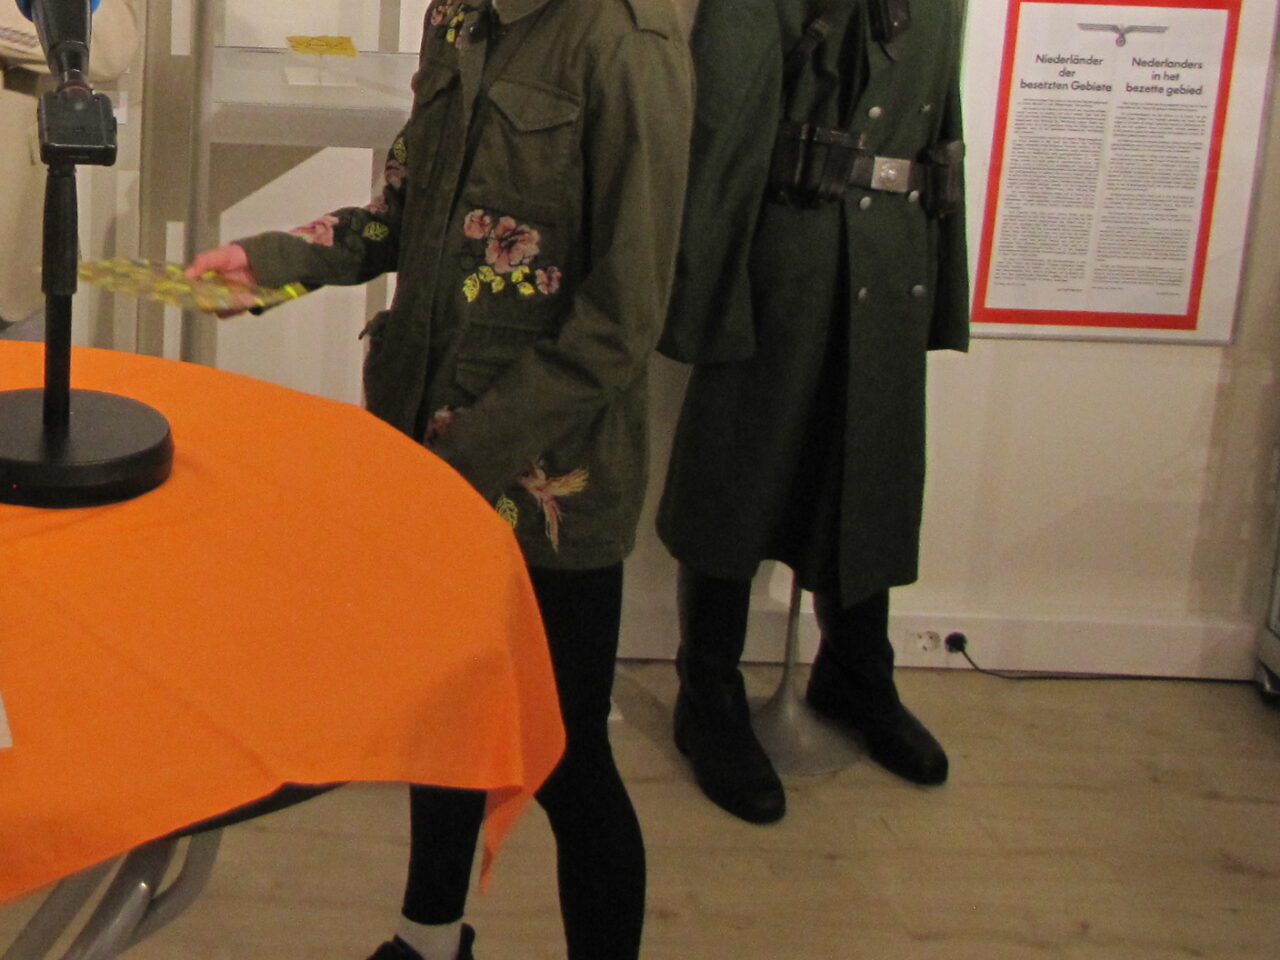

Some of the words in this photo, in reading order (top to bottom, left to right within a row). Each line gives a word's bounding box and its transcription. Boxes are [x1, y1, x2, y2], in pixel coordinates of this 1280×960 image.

[1036, 54, 1104, 66] Niederländer
[1132, 57, 1202, 69] Nederlanders
[1059, 68, 1076, 77] der
[1152, 71, 1160, 80] in
[1163, 71, 1179, 81] het
[1020, 80, 1069, 90] besetzten
[1071, 81, 1112, 92] Gebiete
[1126, 84, 1164, 94] bezette
[1166, 85, 1202, 96] gebied
